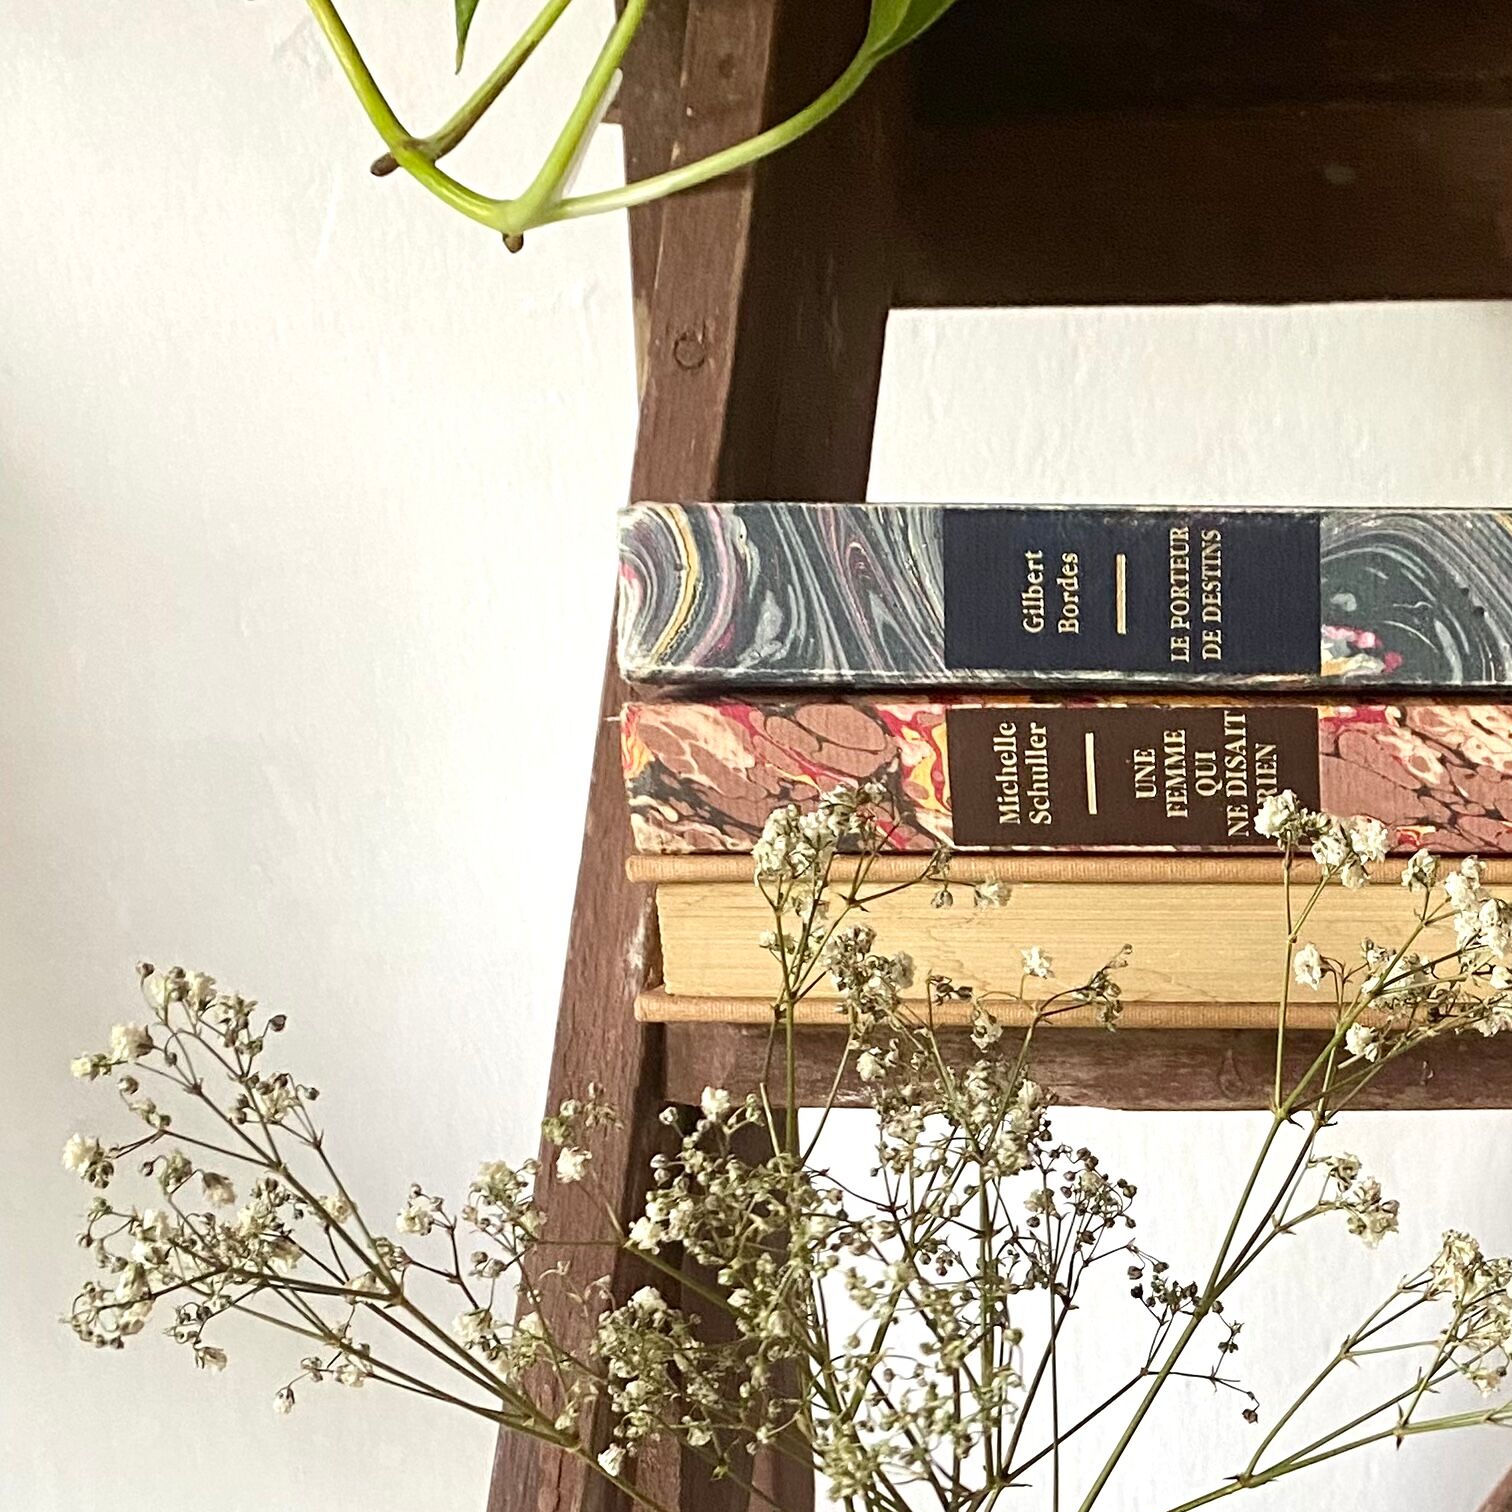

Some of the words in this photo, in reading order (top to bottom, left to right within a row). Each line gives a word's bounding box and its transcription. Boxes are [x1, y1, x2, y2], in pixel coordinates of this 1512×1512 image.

[1022, 550, 1044, 633] Gilbert
[1055, 552, 1079, 634] Bordes
[1170, 526, 1190, 629] PORTEUR
[1201, 529, 1222, 623] DESTINS
[1171, 636, 1190, 663] LE
[1202, 629, 1222, 660] DE
[993, 721, 1021, 824] Michelle
[1025, 722, 1051, 824] Schuller
[1134, 748, 1157, 799] UNE
[1163, 729, 1188, 818] FEMME
[1195, 750, 1224, 796] QUI
[1224, 711, 1248, 799] DISAIT
[1228, 803, 1249, 837] NE
